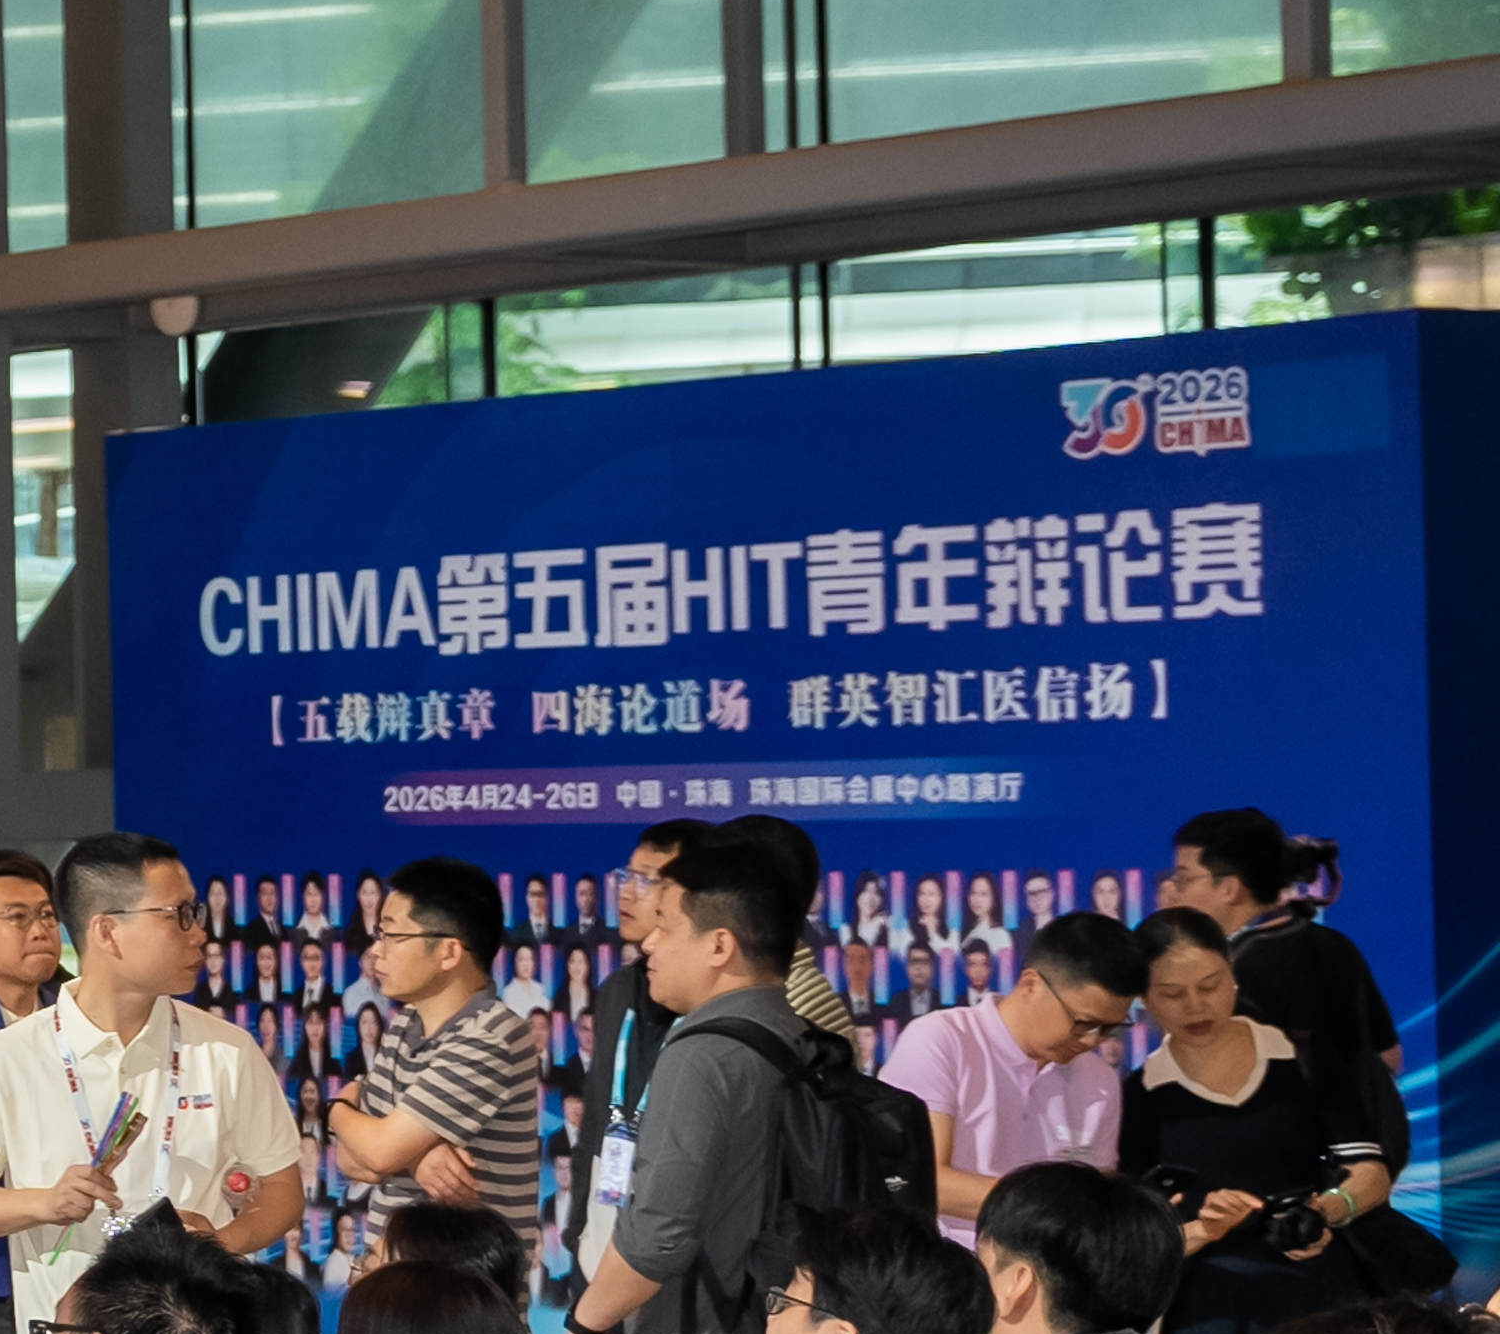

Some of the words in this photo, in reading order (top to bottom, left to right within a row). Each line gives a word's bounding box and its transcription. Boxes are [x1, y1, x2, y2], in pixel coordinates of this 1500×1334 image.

[1160, 371, 1243, 406] 2026
[198, 501, 1265, 657] CHIMA第五届HIT青年辩论赛
[531, 676, 752, 736] 四海论道场
[383, 781, 599, 813] 2026年4月24-26日
